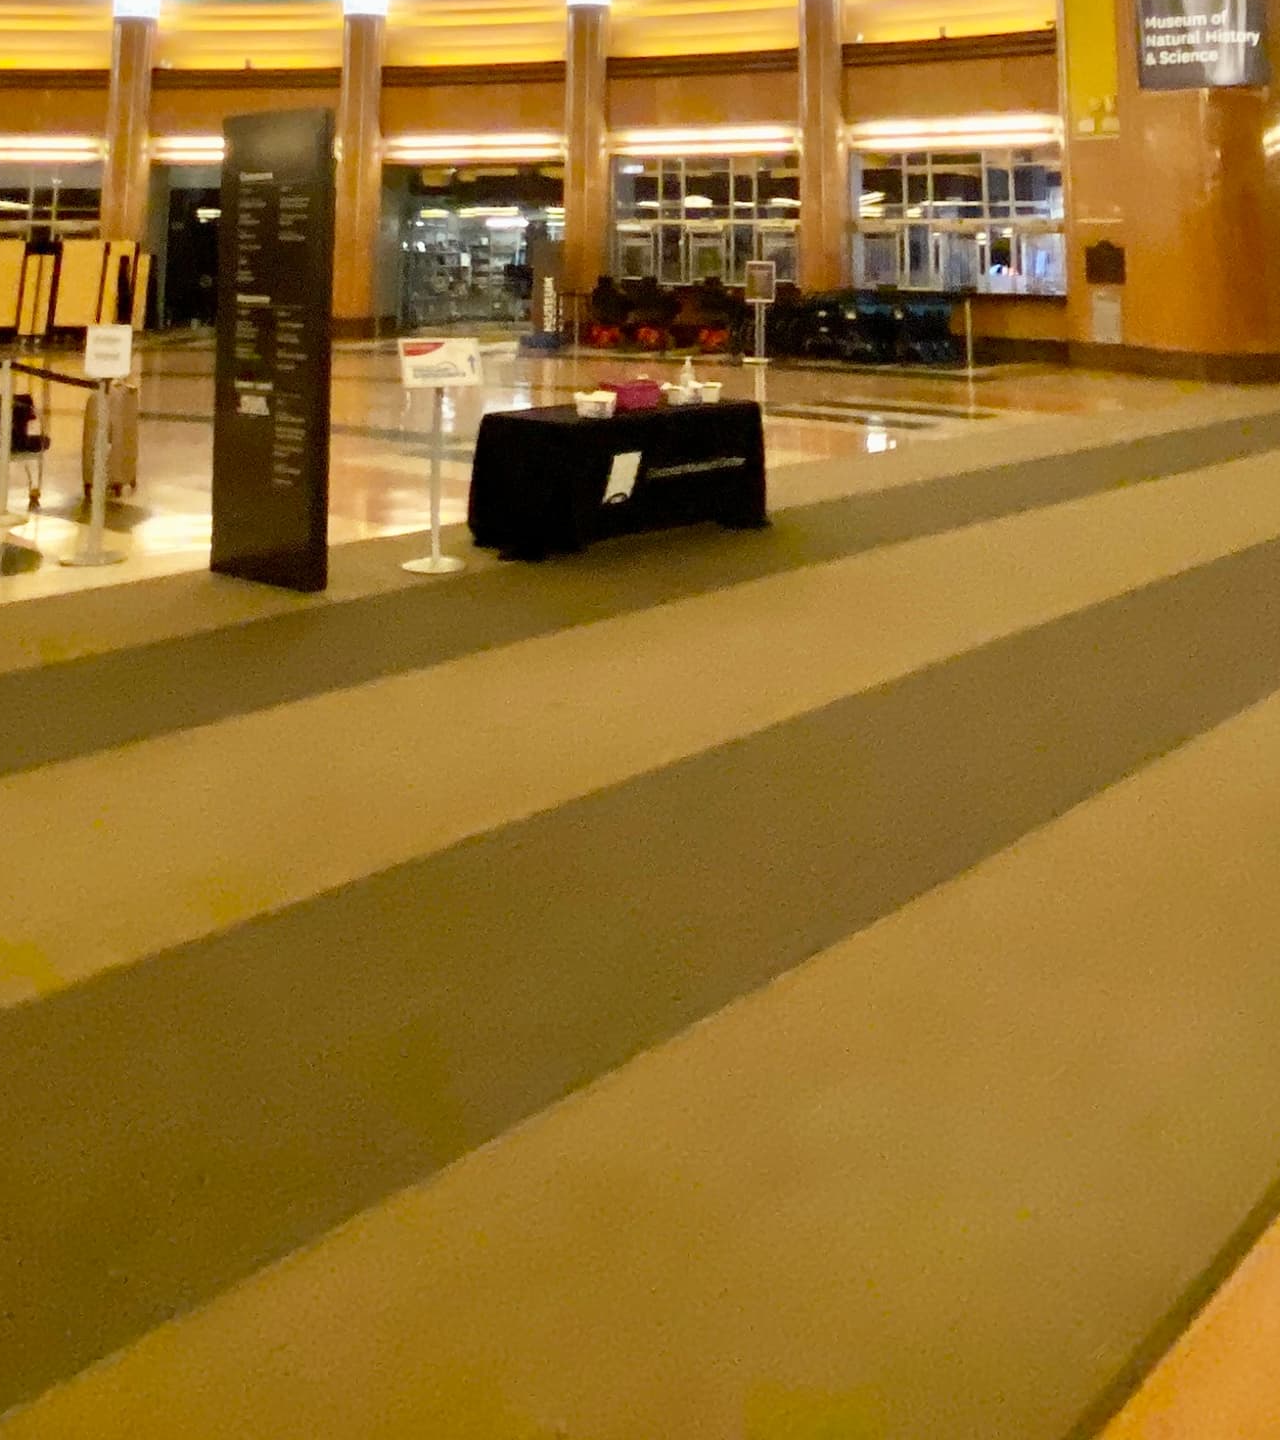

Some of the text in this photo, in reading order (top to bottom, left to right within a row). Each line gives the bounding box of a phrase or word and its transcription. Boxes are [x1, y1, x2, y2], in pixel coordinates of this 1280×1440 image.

[1145, 8, 1228, 29] Museum of
[1145, 29, 1260, 48] Natural History
[1145, 48, 1218, 66] & Science
